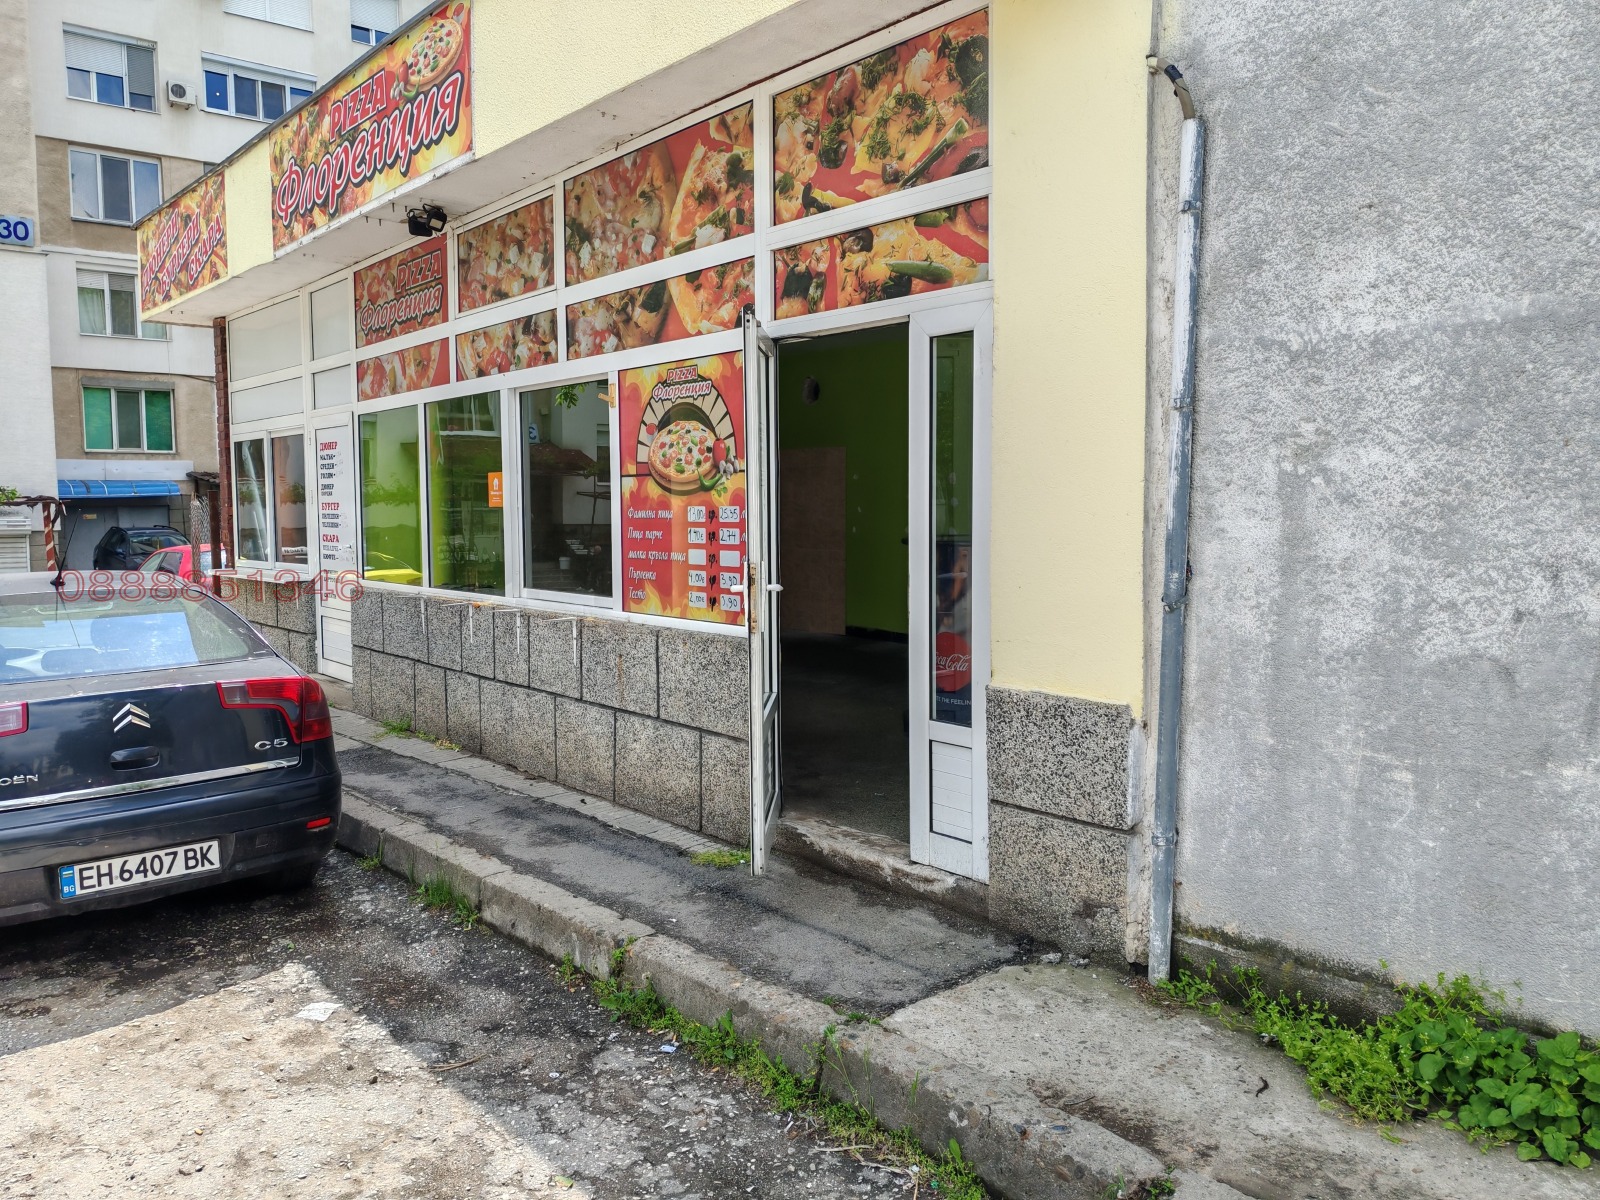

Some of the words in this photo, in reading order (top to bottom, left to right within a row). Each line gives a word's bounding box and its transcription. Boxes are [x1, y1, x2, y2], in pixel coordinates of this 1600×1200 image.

[330, 70, 386, 142] PIZZA
[277, 72, 461, 225] Флоренция
[0, 219, 29, 241] 30
[142, 208, 180, 300] ДЮНЕРИ
[160, 209, 201, 300] БУРГЕРИ
[188, 213, 223, 285] СКАРА
[396, 251, 442, 292] PIZZA
[361, 284, 442, 334] Флоренция
[667, 366, 698, 383] PIZZA
[653, 381, 712, 403] Флоренция
[320, 442, 337, 451] ДЮНЕР
[321, 502, 339, 510] БУРГЕР
[628, 507, 656, 519] Фамилна
[657, 510, 674, 522] пица
[322, 534, 339, 542] СКАРА
[628, 527, 643, 541] Пица
[645, 530, 663, 544] парче
[628, 550, 646, 559] малка
[648, 550, 668, 564] кръгла
[670, 552, 687, 564] пица
[629, 587, 646, 599] Тесто
[254, 737, 288, 750] C5
[79, 863, 114, 891] EH
[119, 851, 179, 882] 6407
[184, 845, 216, 870] BK
[63, 885, 75, 893] BG
